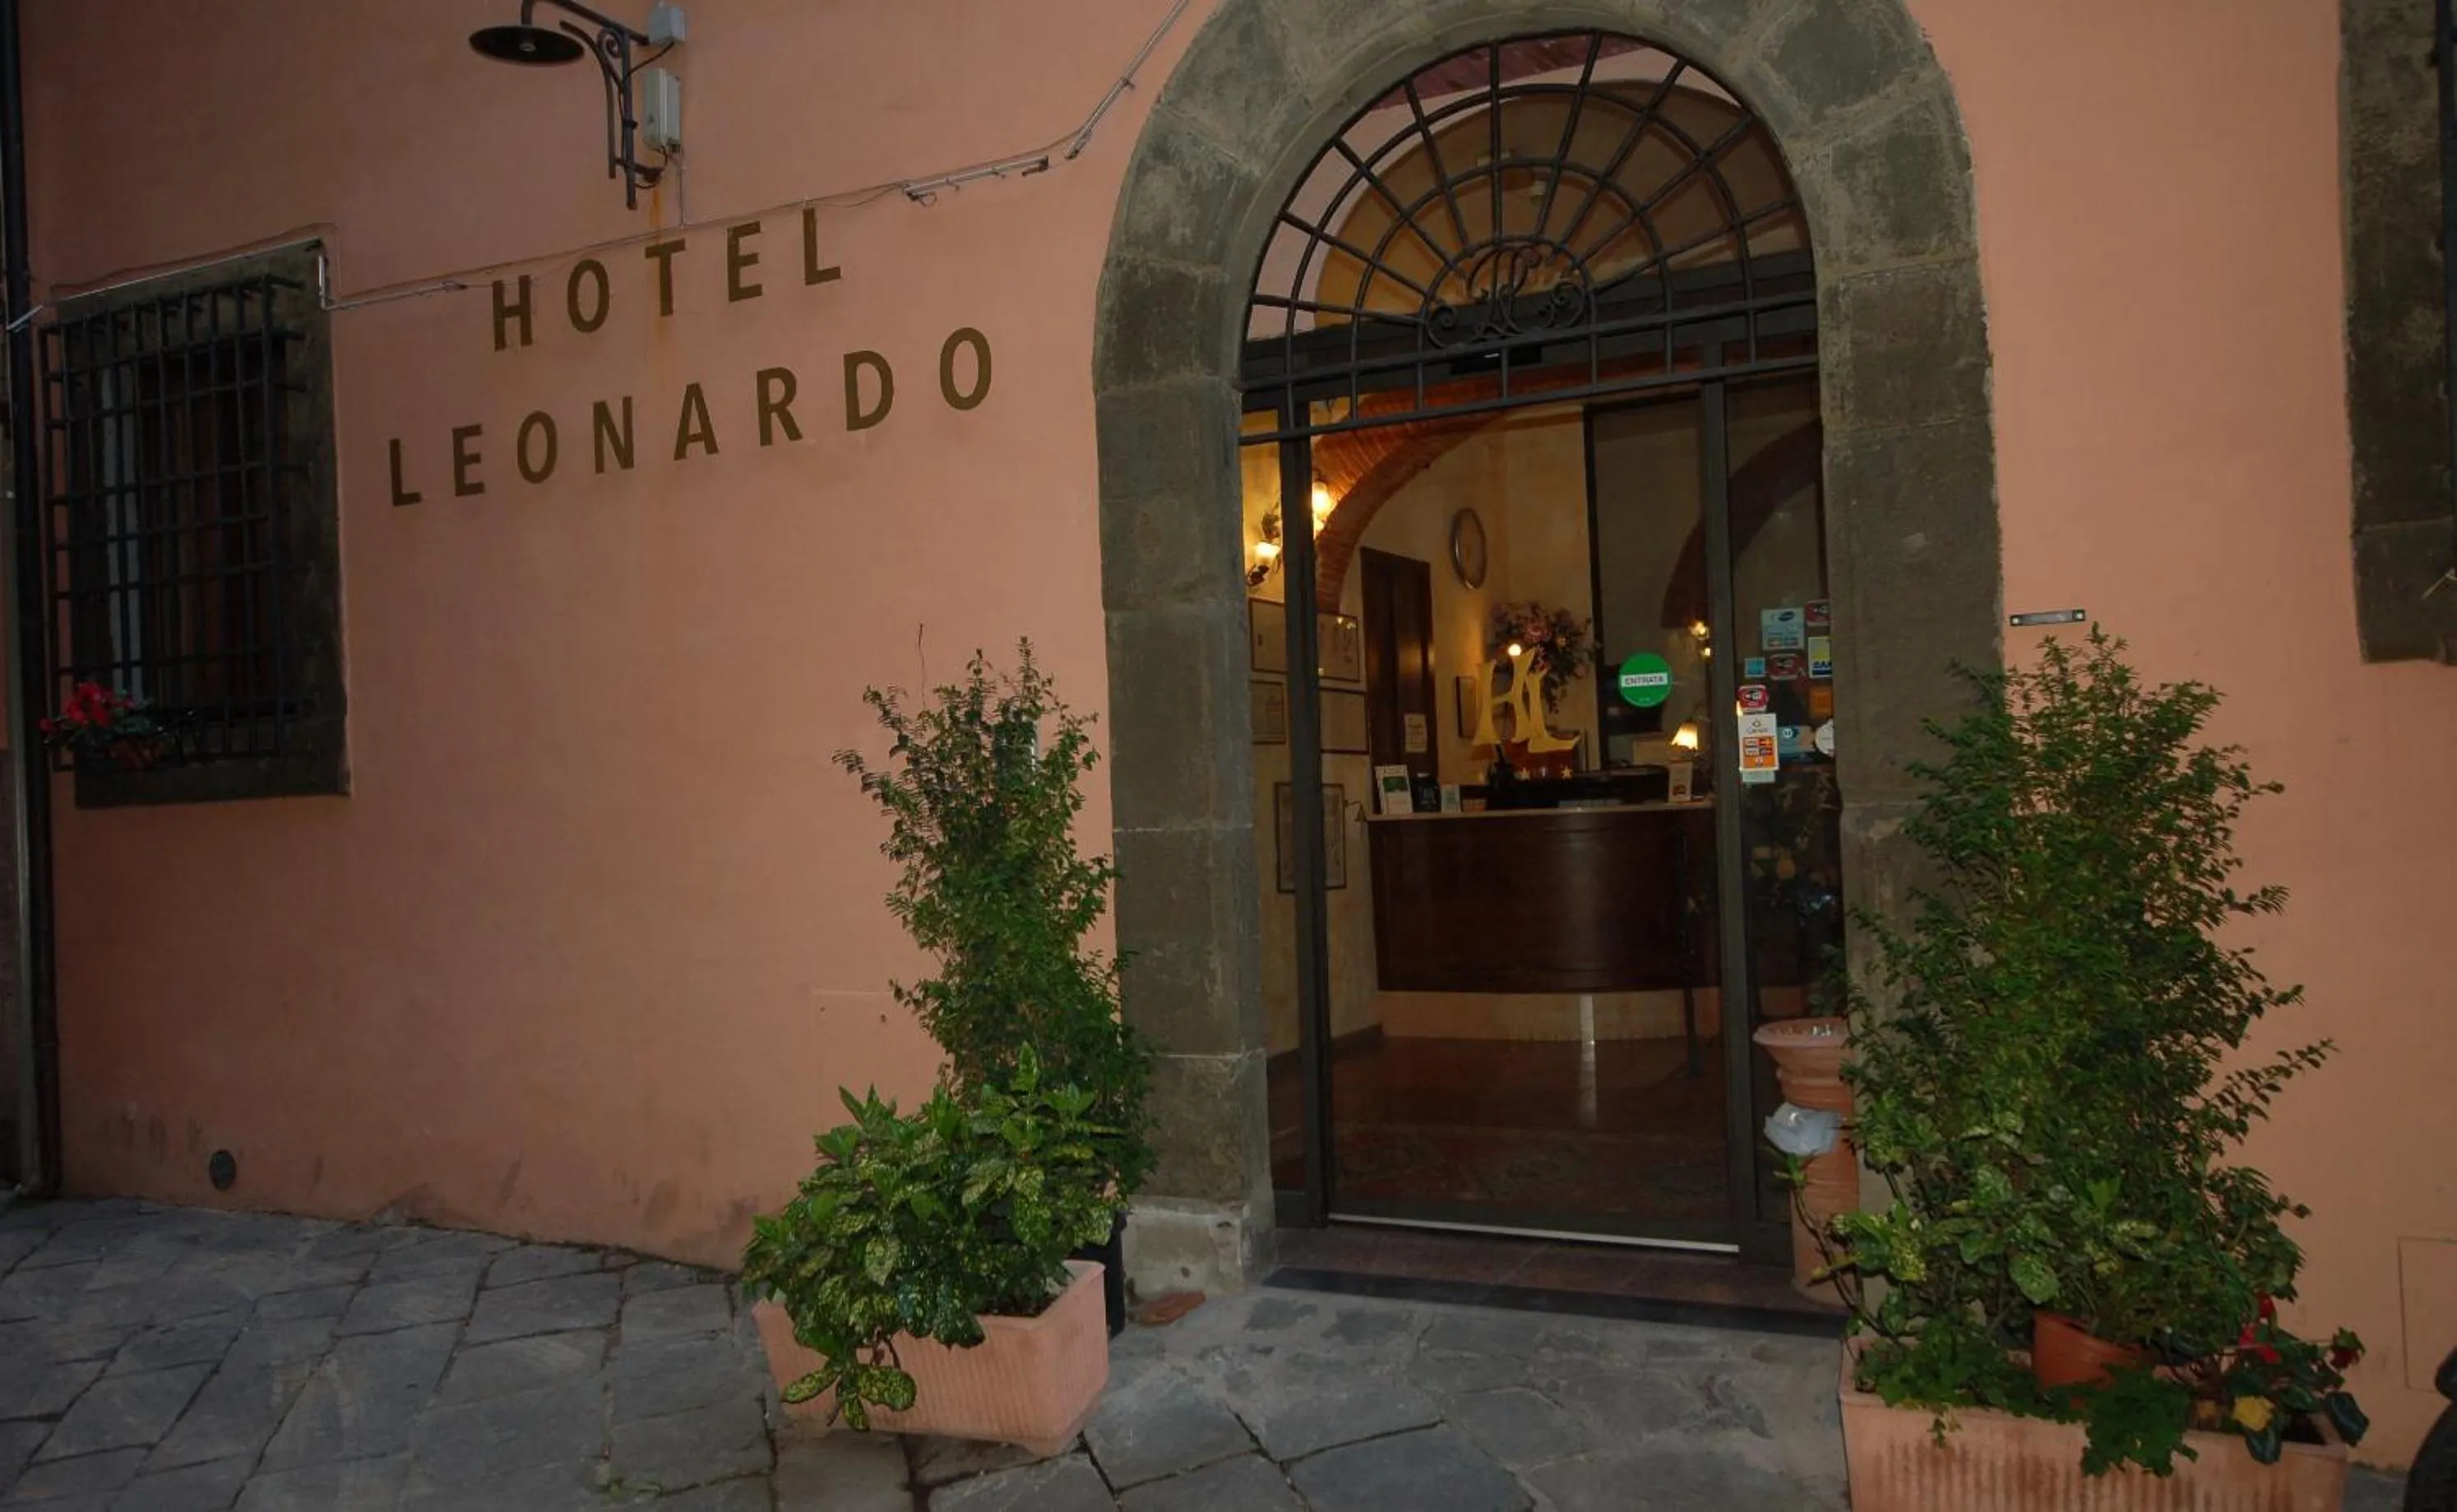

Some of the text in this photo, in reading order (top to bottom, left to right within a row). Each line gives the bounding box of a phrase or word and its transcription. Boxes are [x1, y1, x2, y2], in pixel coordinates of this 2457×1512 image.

[493, 208, 841, 351] HOTEL
[390, 327, 992, 506] LEONARDO
[1624, 675, 1663, 686] ENTRATA
